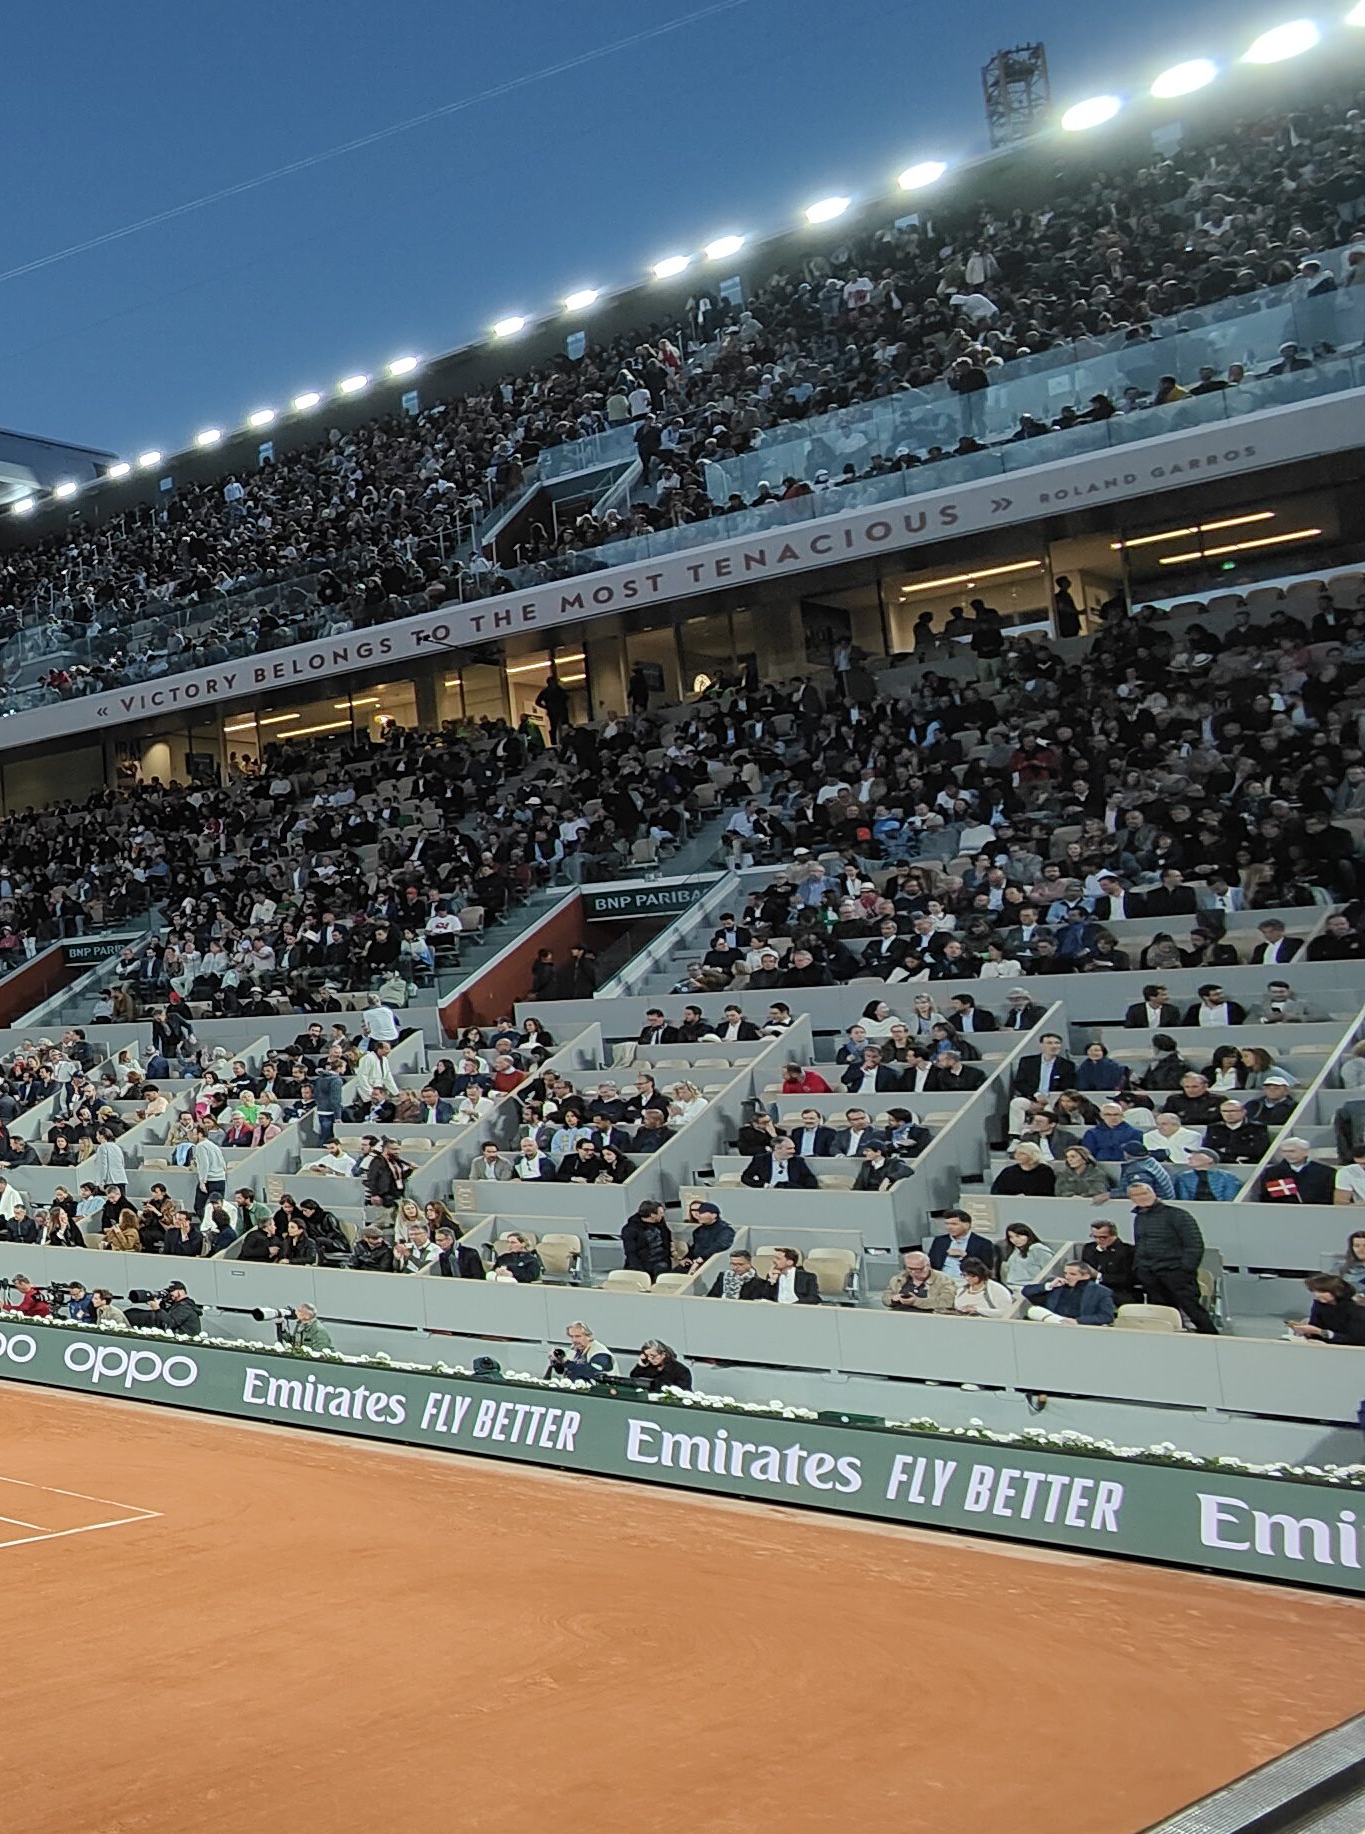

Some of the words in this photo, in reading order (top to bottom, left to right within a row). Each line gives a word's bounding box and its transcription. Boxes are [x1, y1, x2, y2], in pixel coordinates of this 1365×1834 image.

[1039, 471, 1138, 504] ROLAND
[1150, 445, 1257, 478] GARROS
[121, 674, 237, 713] VICTORY
[254, 637, 392, 684] BELONGS
[411, 624, 452, 646] TO
[470, 603, 537, 633] THE
[560, 573, 664, 613] MOST
[687, 504, 960, 584] TENACIOUS
[595, 895, 632, 911] BNP
[64, 1341, 199, 1389] oppo
[242, 1367, 407, 1426] Emirates
[420, 1392, 472, 1435] FLY
[473, 1399, 581, 1452] BETTER
[626, 1418, 862, 1494] Emirates
[886, 1454, 957, 1508] FLY
[964, 1464, 1124, 1533] BETTER
[1195, 1492, 1365, 1569] Emi
